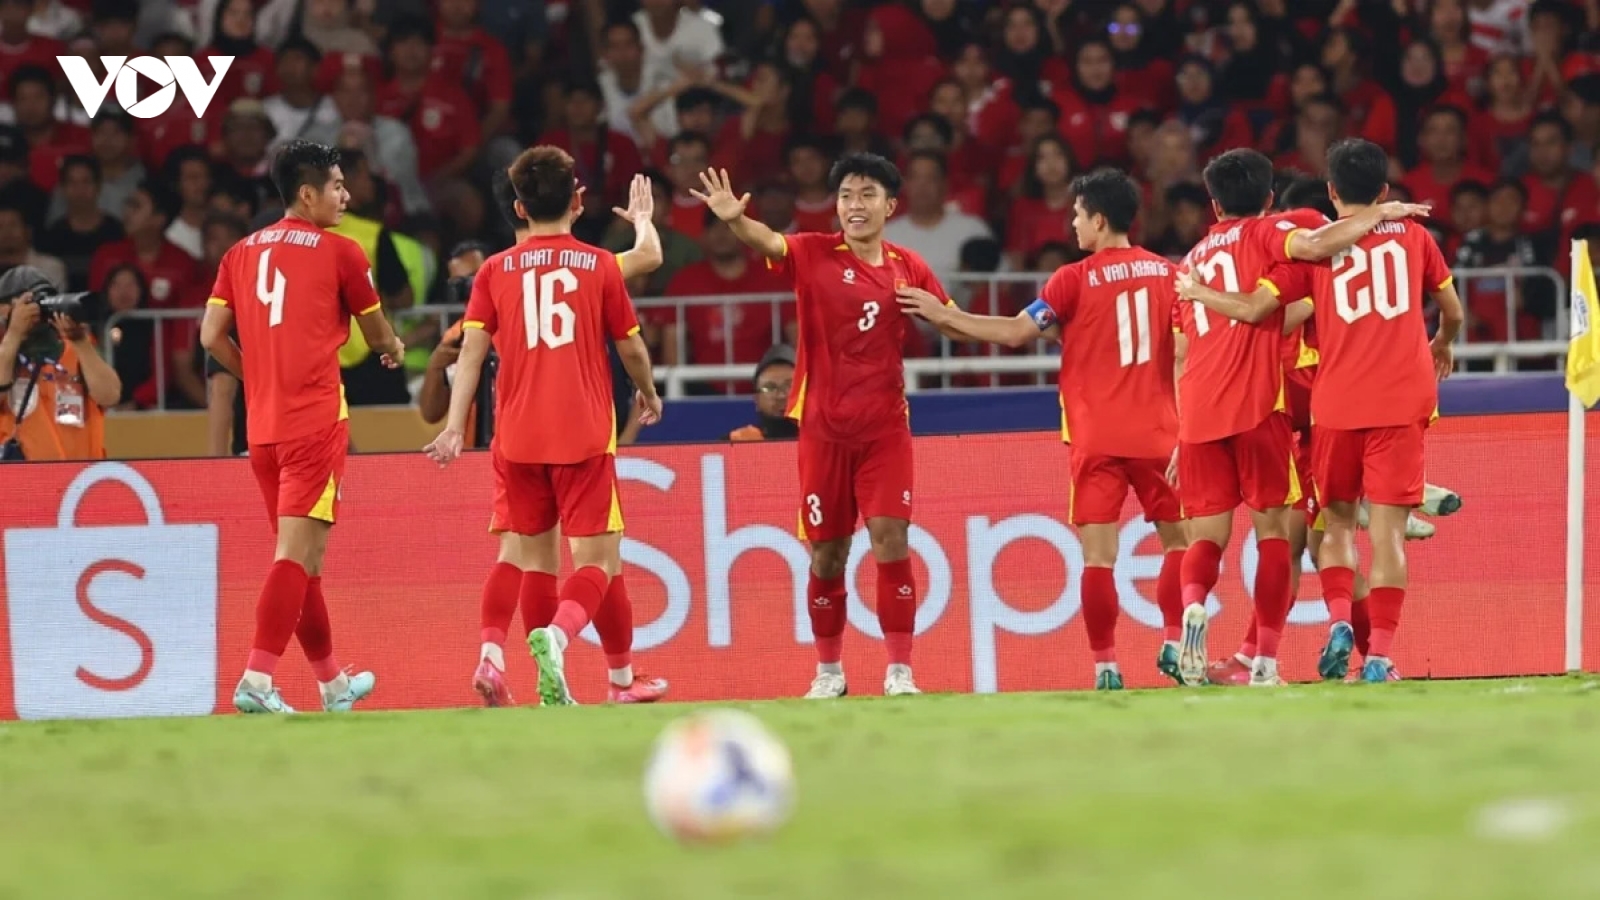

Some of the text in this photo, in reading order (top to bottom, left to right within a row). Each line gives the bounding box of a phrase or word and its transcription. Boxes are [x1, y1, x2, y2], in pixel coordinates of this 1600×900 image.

[283, 229, 321, 249] MINH
[520, 248, 555, 270] NHAT
[558, 249, 597, 272] MINH
[256, 247, 287, 328] 4
[1087, 259, 1169, 288] K. VAN KHANG
[1331, 238, 1410, 325] 20
[522, 267, 579, 351] 16
[857, 300, 880, 332] 3
[1115, 286, 1152, 369] 11
[806, 492, 823, 527] 3
[75, 558, 154, 691] S
